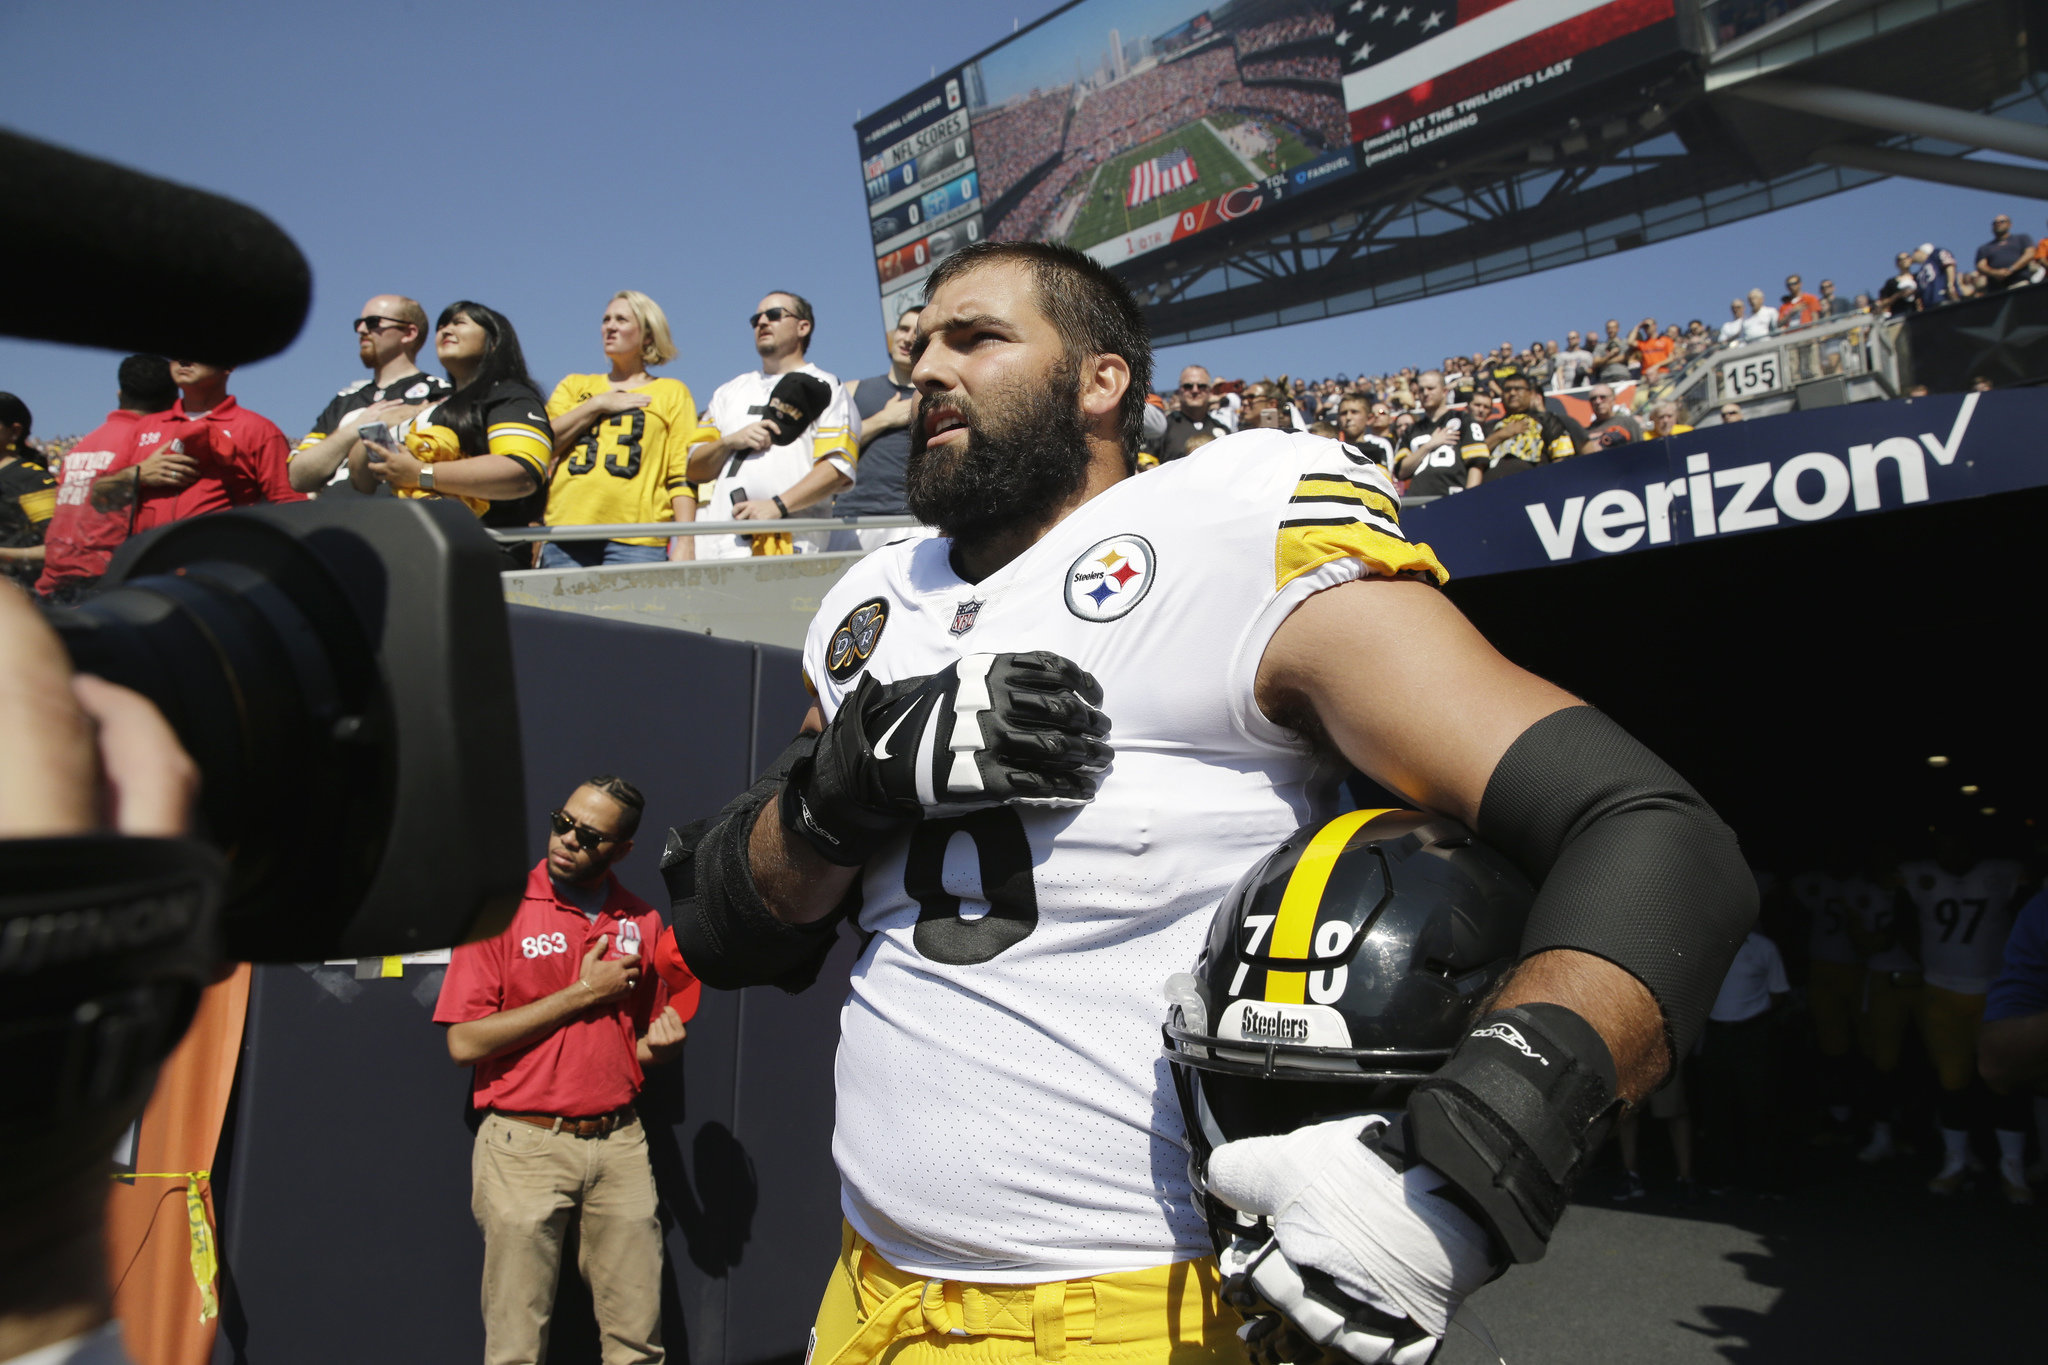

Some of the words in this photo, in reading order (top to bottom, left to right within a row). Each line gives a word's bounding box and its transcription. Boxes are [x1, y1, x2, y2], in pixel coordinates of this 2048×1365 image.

[1409, 116, 1426, 133] AT
[1428, 107, 1455, 125] THE
[1456, 76, 1534, 114] TWILIGHT'S
[1535, 58, 1573, 83] LAST
[892, 141, 913, 164] NFL
[917, 114, 961, 147] SCORES
[1411, 113, 1478, 148] GLEAMING
[954, 137, 966, 158] 0
[902, 164, 914, 185] 0
[1307, 157, 1350, 180] FANDUEL
[961, 178, 972, 200] 0
[908, 203, 919, 225] 0
[1183, 212, 1195, 231] 0
[967, 219, 978, 241] 0
[914, 243, 925, 265] 0
[1727, 359, 1776, 394] 155
[1525, 436, 1930, 561] verizon
[1073, 569, 1105, 584] Steelers
[953, 612, 976, 632] NFL
[1934, 896, 1988, 945] 97
[521, 931, 568, 959] 863
[1241, 1004, 1310, 1041] Steelers
